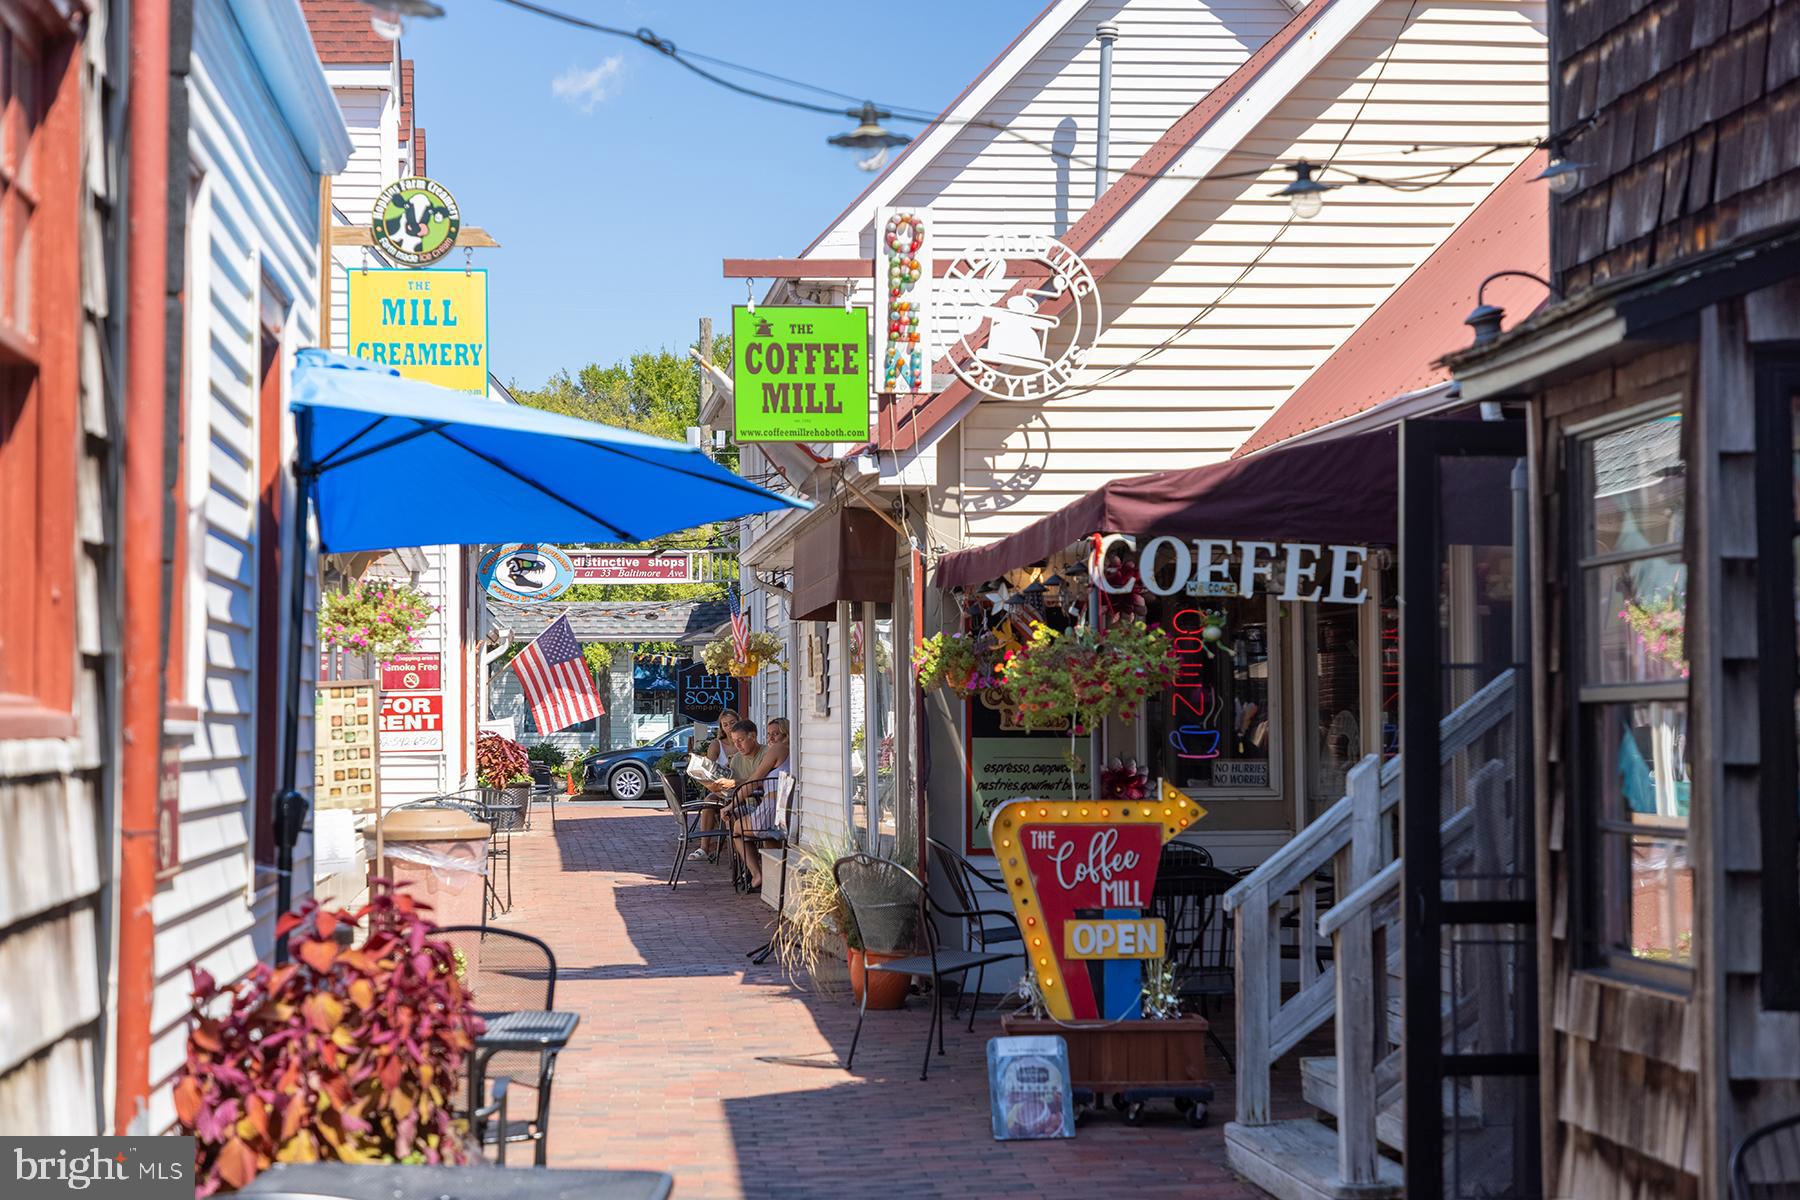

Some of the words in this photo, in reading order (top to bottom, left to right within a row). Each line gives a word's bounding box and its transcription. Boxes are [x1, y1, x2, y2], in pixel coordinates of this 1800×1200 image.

[400, 179, 427, 193] Farm
[427, 181, 459, 220] Creamery
[395, 250, 419, 262] made
[431, 237, 454, 257] Cream
[937, 235, 1096, 313] ELERATING
[408, 281, 431, 291] THE
[381, 298, 458, 327] MILL
[789, 323, 814, 335] THE
[356, 342, 483, 366] CREAMERY
[745, 341, 859, 375] COFFEE
[967, 362, 996, 392] 28
[1005, 345, 1091, 399] YEARS
[761, 382, 843, 414] MILL
[740, 427, 865, 438] www.coffeemillrehoboth.com
[573, 557, 640, 567] distinctive
[647, 557, 685, 569] shops
[584, 569, 594, 577] at
[600, 569, 611, 577] 33
[617, 568, 661, 577] Baltimore
[667, 569, 685, 577] Ave.
[1090, 532, 1368, 605] COFFEE
[1188, 582, 1235, 593] WECOME
[384, 662, 416, 672] Smoke
[417, 662, 439, 671] Free
[685, 675, 732, 689] LEH
[380, 698, 431, 714] FOR
[684, 690, 735, 710] SOAP
[983, 762, 1031, 776] espresso,
[1216, 763, 1229, 773] NO
[1231, 763, 1265, 774] HURRIES
[1215, 774, 1228, 785] NO
[1230, 774, 1265, 785] WORRIES
[1030, 830, 1056, 850] THE
[1047, 828, 1140, 890] Coffee
[1100, 879, 1144, 907] MILL
[1072, 923, 1158, 955] OPEN
